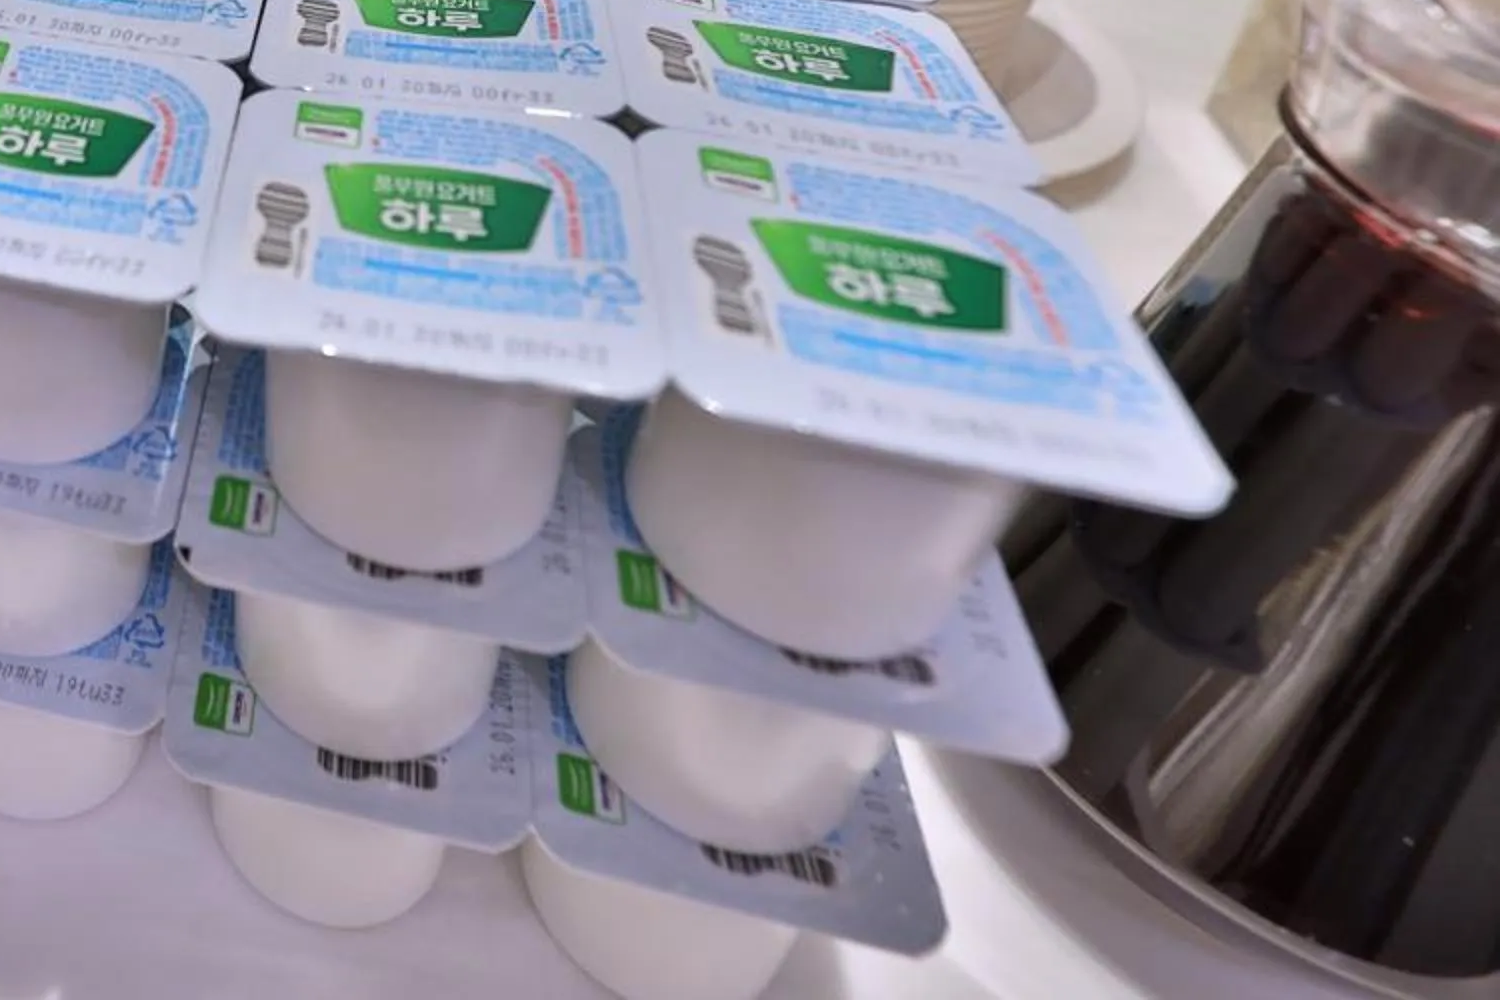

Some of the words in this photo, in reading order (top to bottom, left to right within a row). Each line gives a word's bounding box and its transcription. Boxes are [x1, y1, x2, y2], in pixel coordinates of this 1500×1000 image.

[396, 5, 484, 32] 하루
[753, 47, 851, 82] 하루
[380, 197, 490, 242] 하루
[825, 260, 956, 318] 하루
